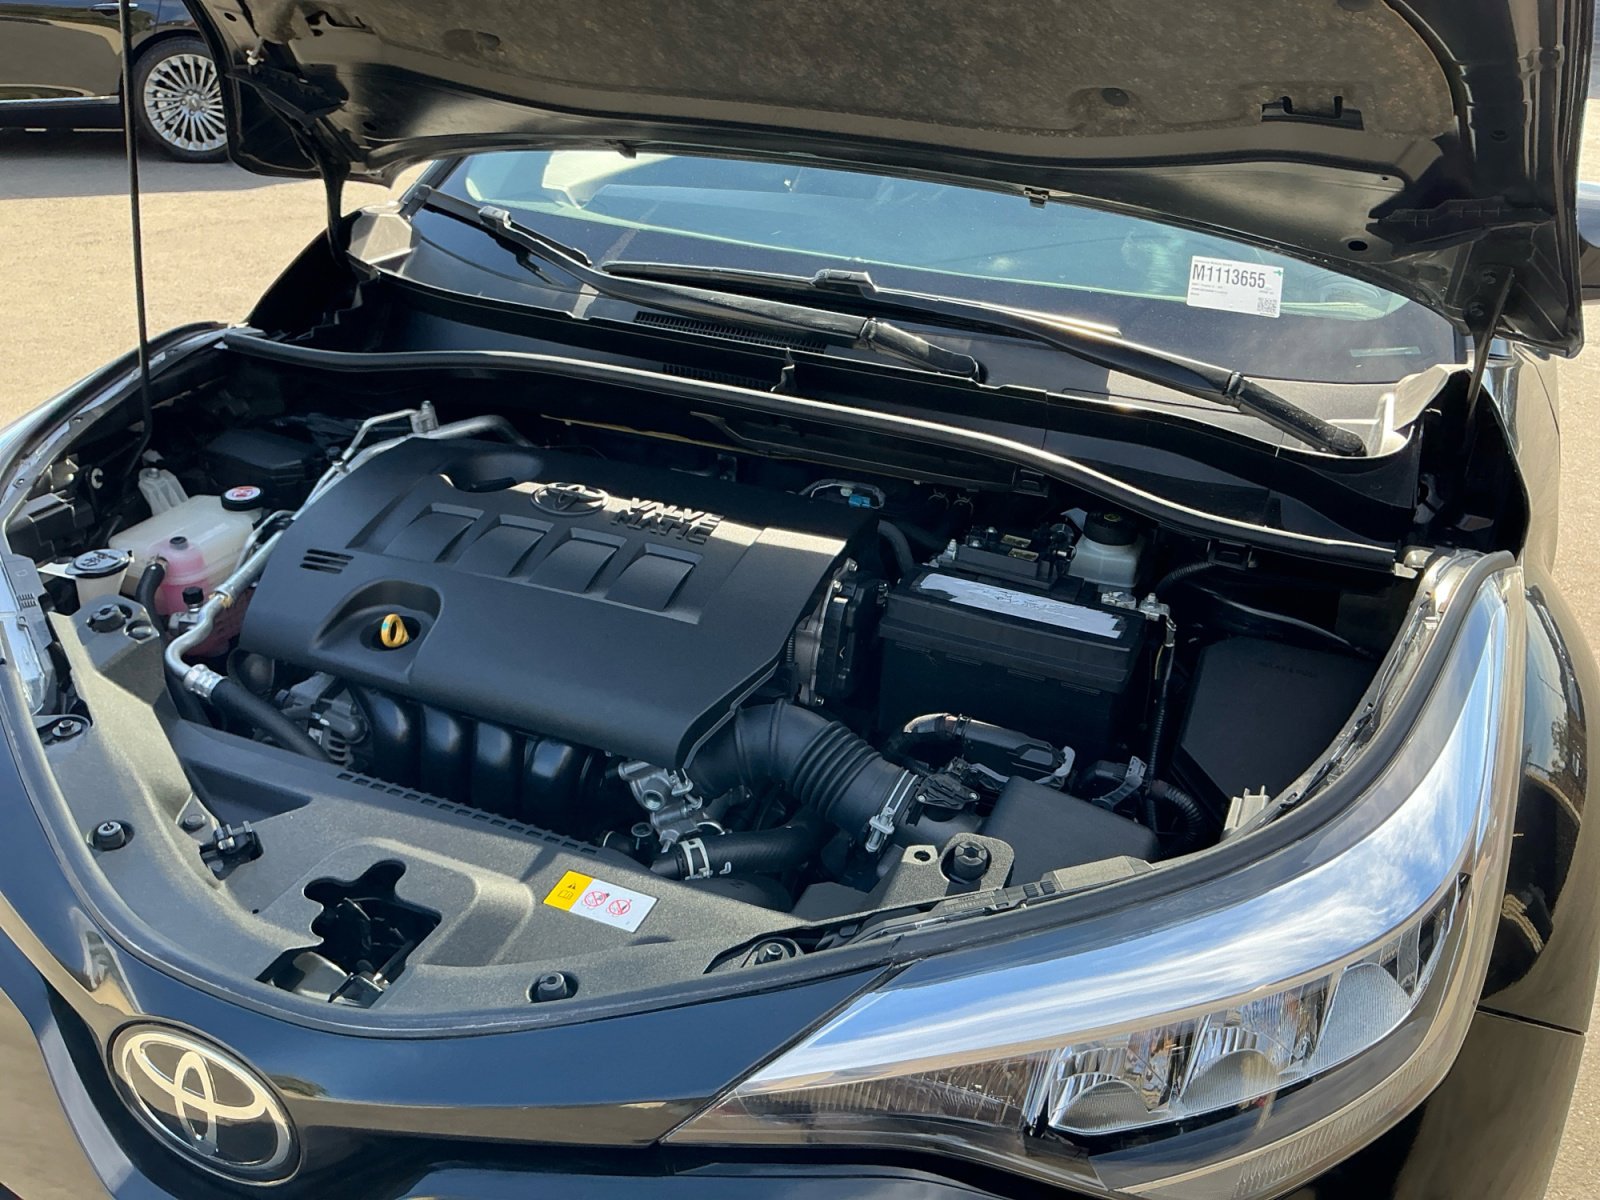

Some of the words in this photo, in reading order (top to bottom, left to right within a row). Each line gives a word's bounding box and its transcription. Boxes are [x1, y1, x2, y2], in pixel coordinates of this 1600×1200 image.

[1192, 264, 1266, 289] M1113655
[609, 508, 714, 545] MATIC
[630, 497, 725, 530] VALVE
